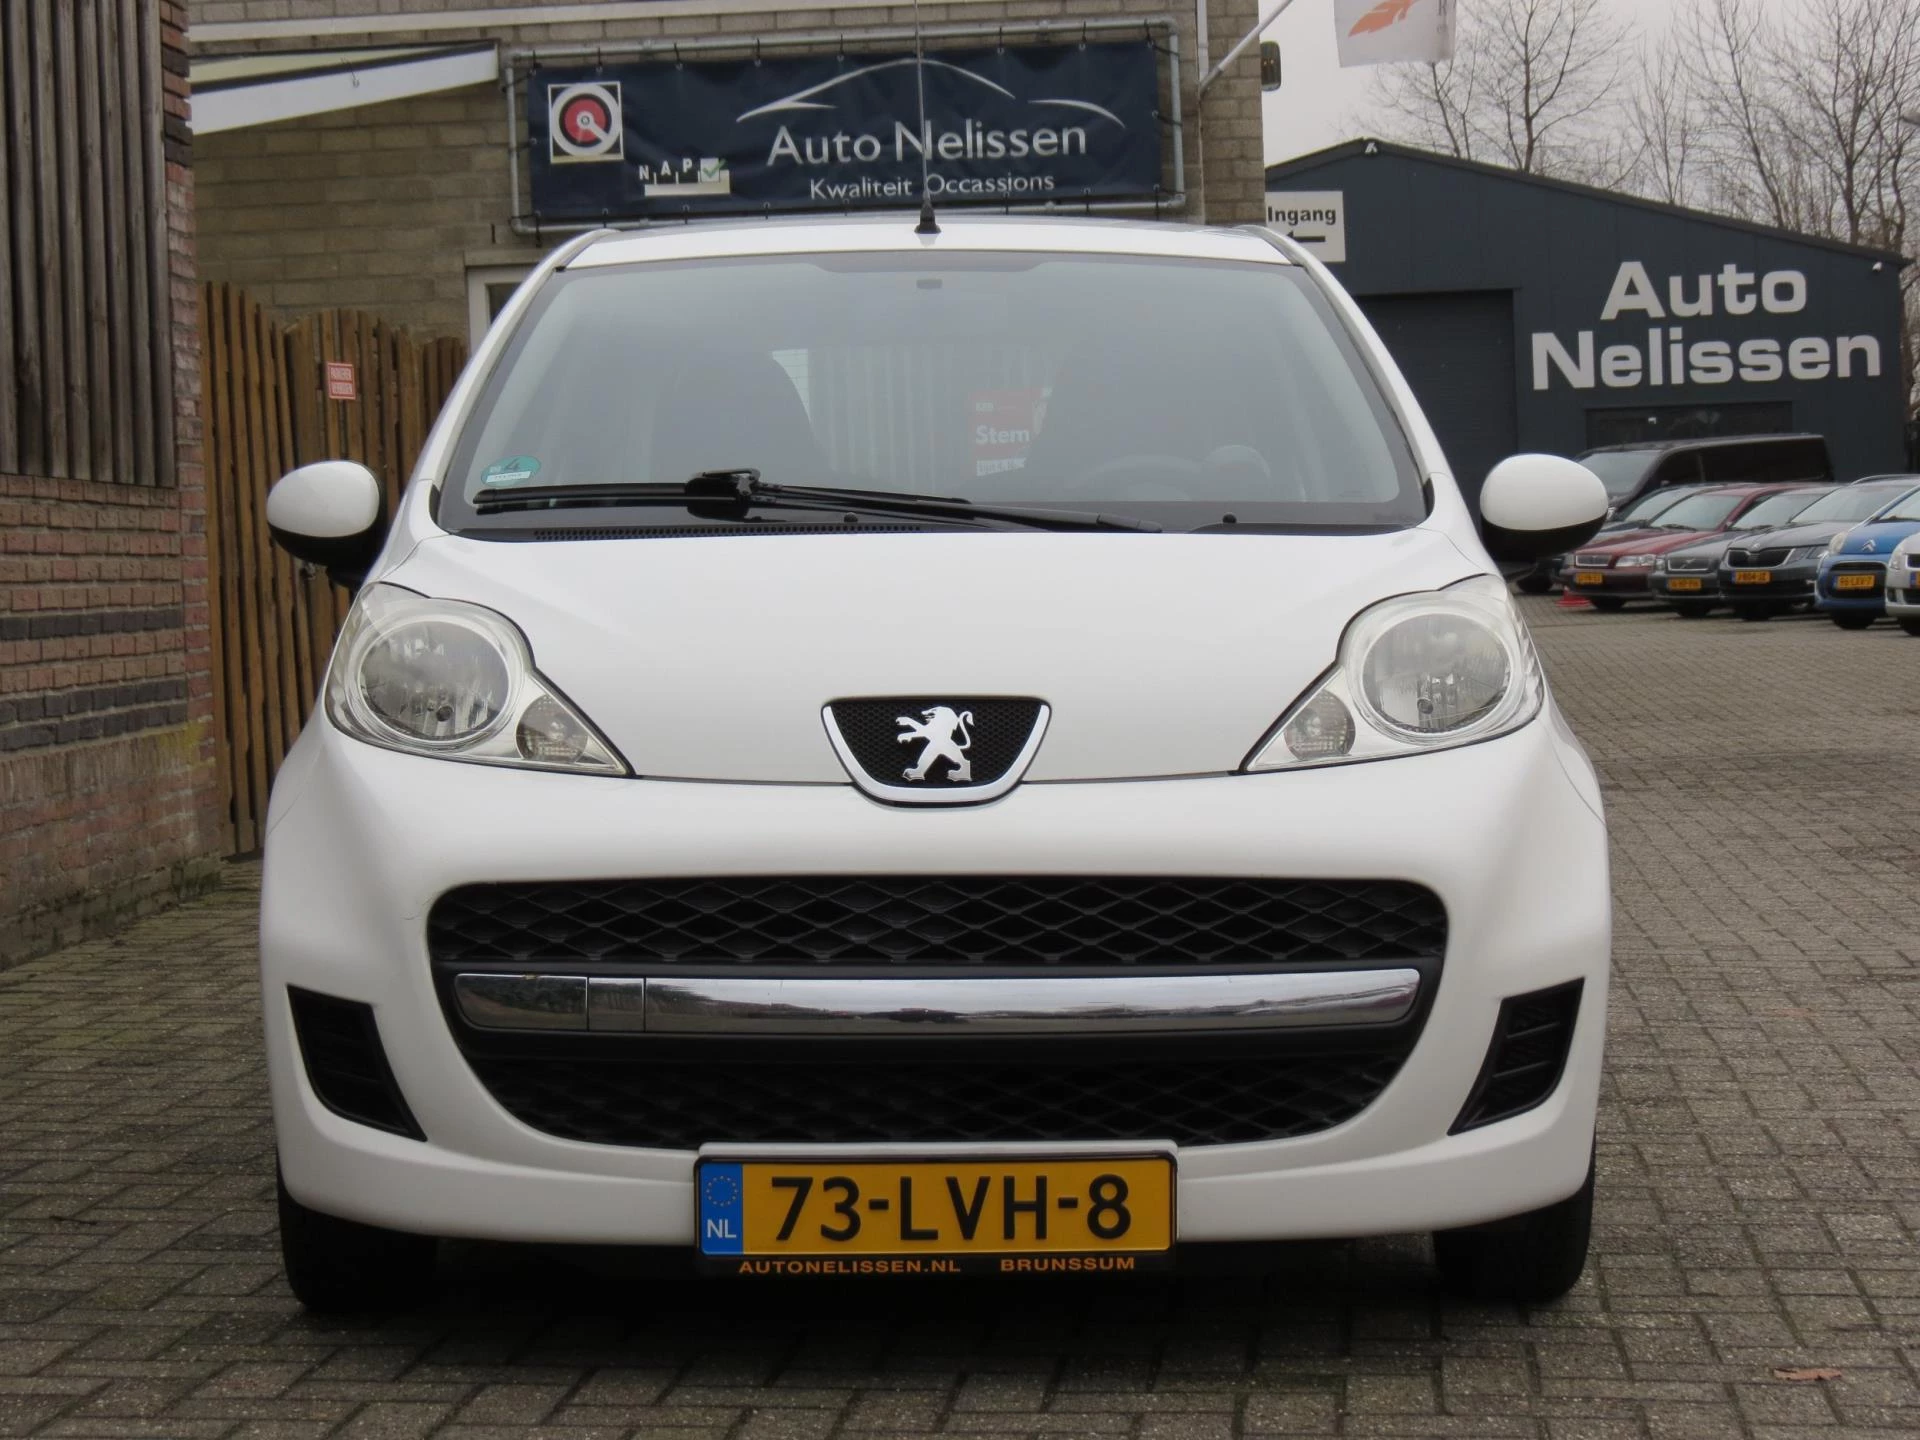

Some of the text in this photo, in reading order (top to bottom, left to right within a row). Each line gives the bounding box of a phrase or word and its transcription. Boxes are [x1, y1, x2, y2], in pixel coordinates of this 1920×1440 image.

[766, 118, 1086, 167] Auto Nelissen
[810, 172, 1055, 200] Kwaliteit Occassions
[1267, 206, 1336, 225] Ingang
[1600, 261, 1807, 320] Auto
[1531, 327, 1881, 391] Nelissen
[976, 425, 1030, 445] Stem
[770, 1173, 1132, 1242] 73-LVH-8
[706, 1219, 737, 1239] NL
[738, 1256, 1135, 1274] AUTONELISSEN.NL BRUNSSUM
